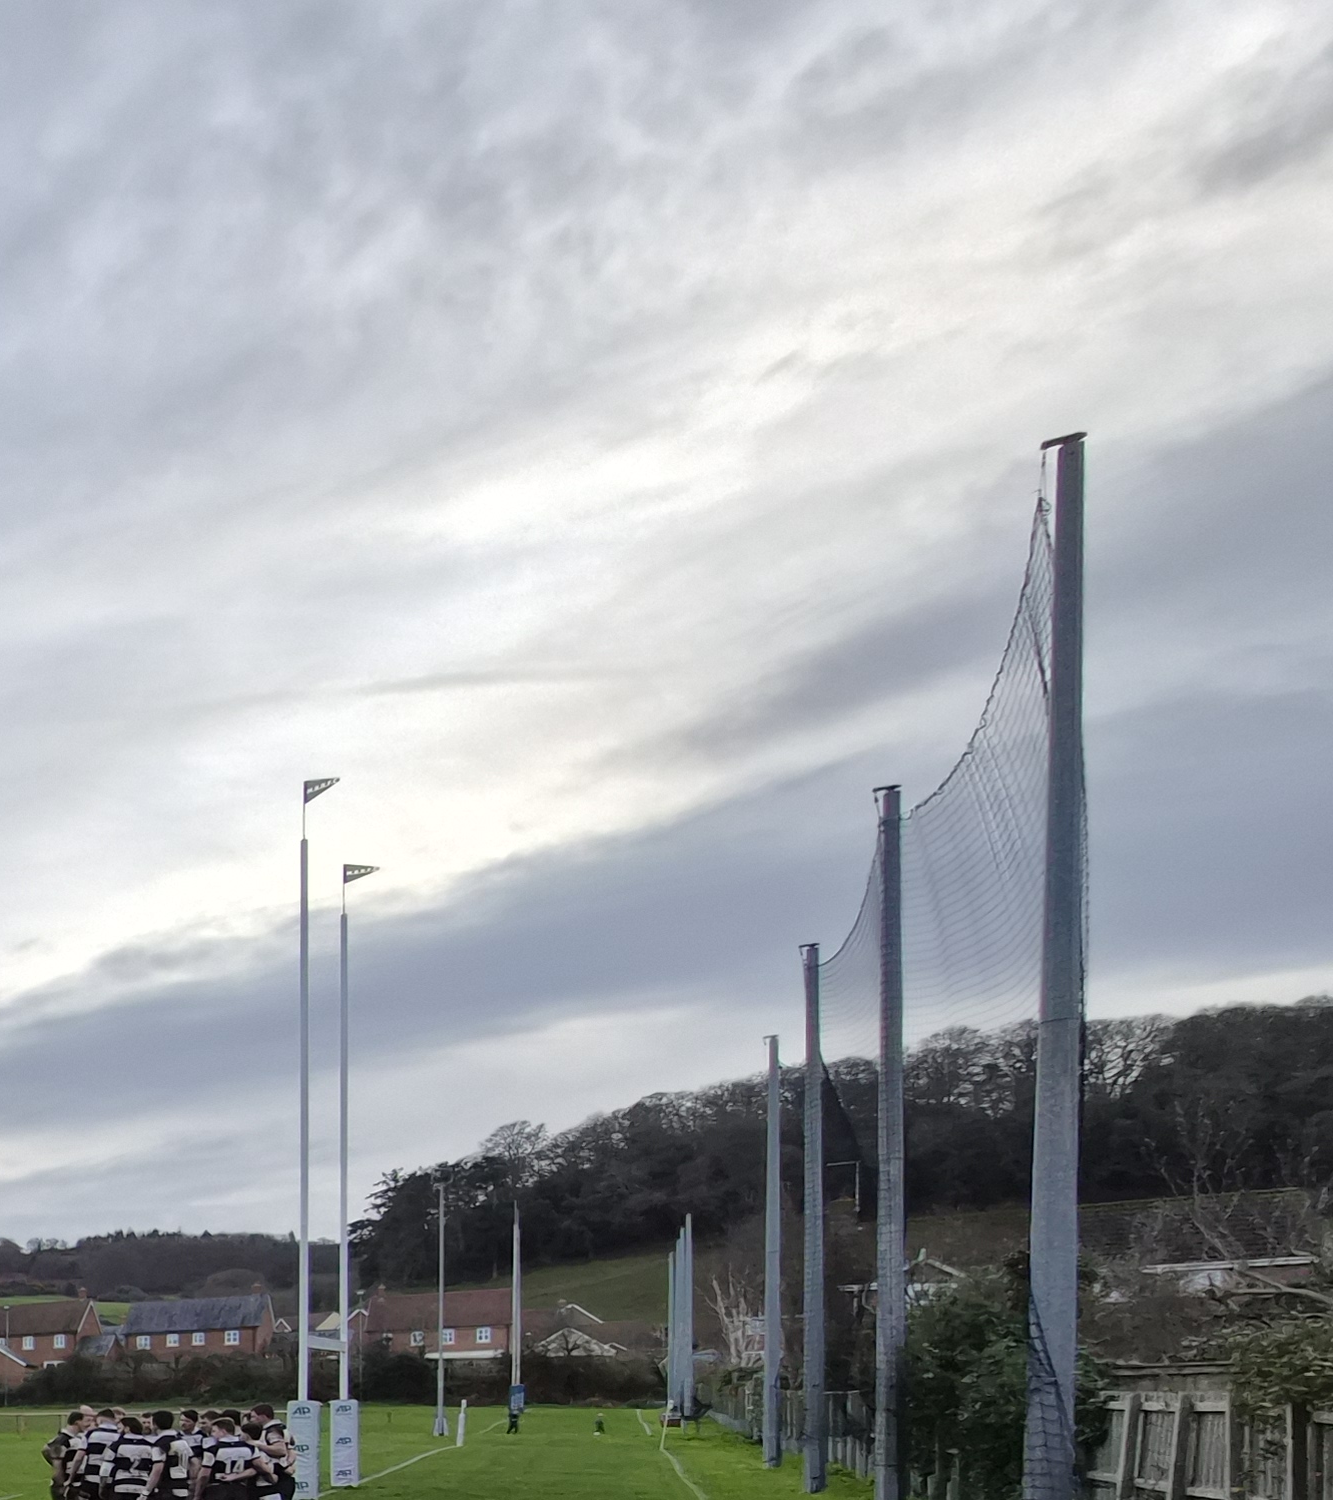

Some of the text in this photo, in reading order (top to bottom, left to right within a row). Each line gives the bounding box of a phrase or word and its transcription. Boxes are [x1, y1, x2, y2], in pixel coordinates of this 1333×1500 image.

[293, 1406, 311, 1415] AP
[335, 1437, 352, 1445] AP
[294, 1444, 309, 1453] AP
[224, 1456, 246, 1474] 14
[336, 1469, 352, 1477] AP
